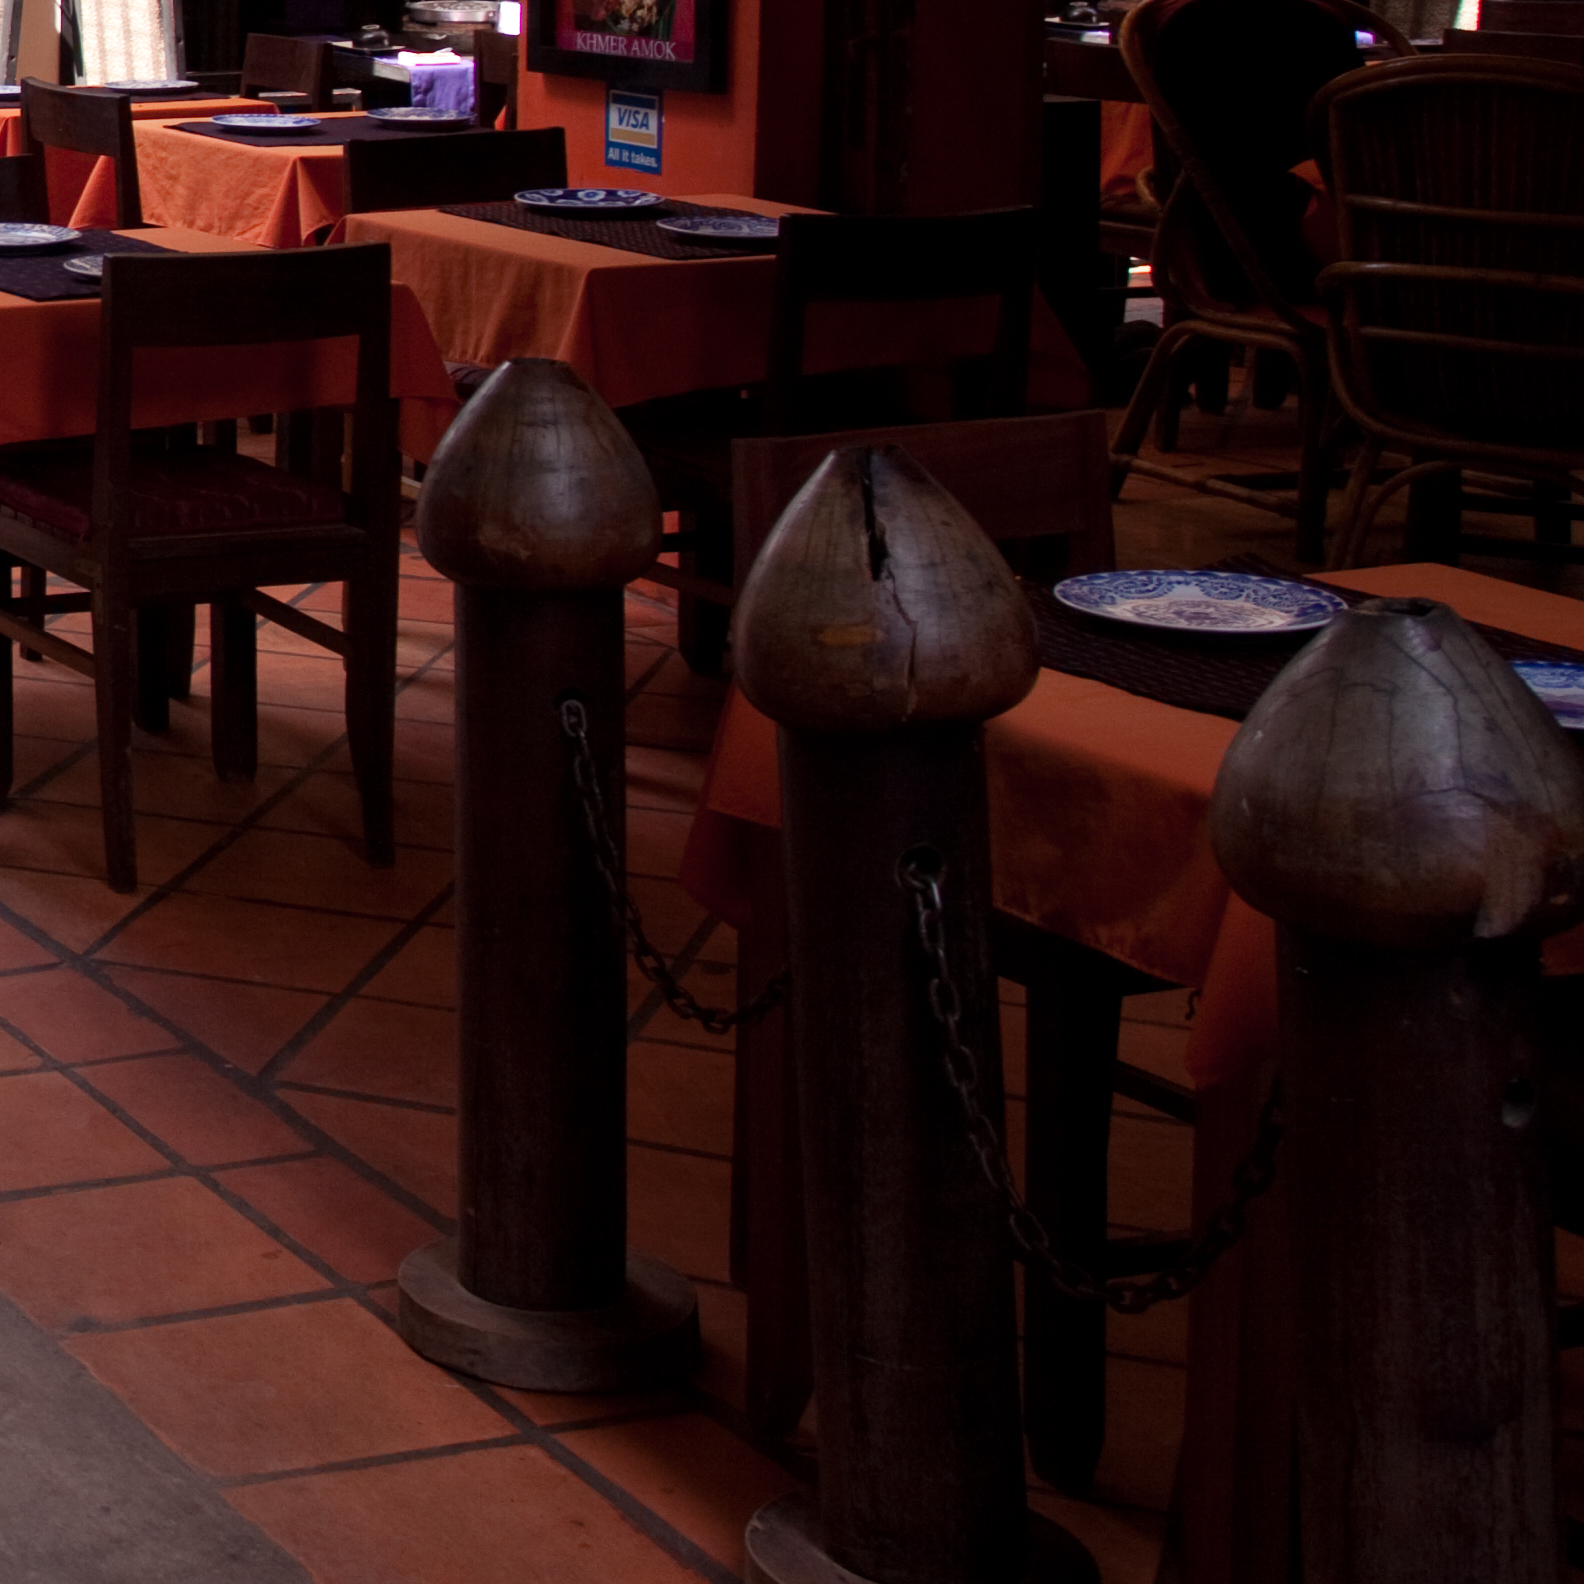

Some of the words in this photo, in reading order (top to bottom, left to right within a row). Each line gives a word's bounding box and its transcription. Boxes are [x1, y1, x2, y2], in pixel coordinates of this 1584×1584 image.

[576, 30, 629, 54] KHMER
[630, 37, 677, 61] AMOK
[617, 107, 651, 131] VISA
[607, 146, 620, 161] All
[621, 148, 630, 163] it
[630, 150, 658, 168] takes.
